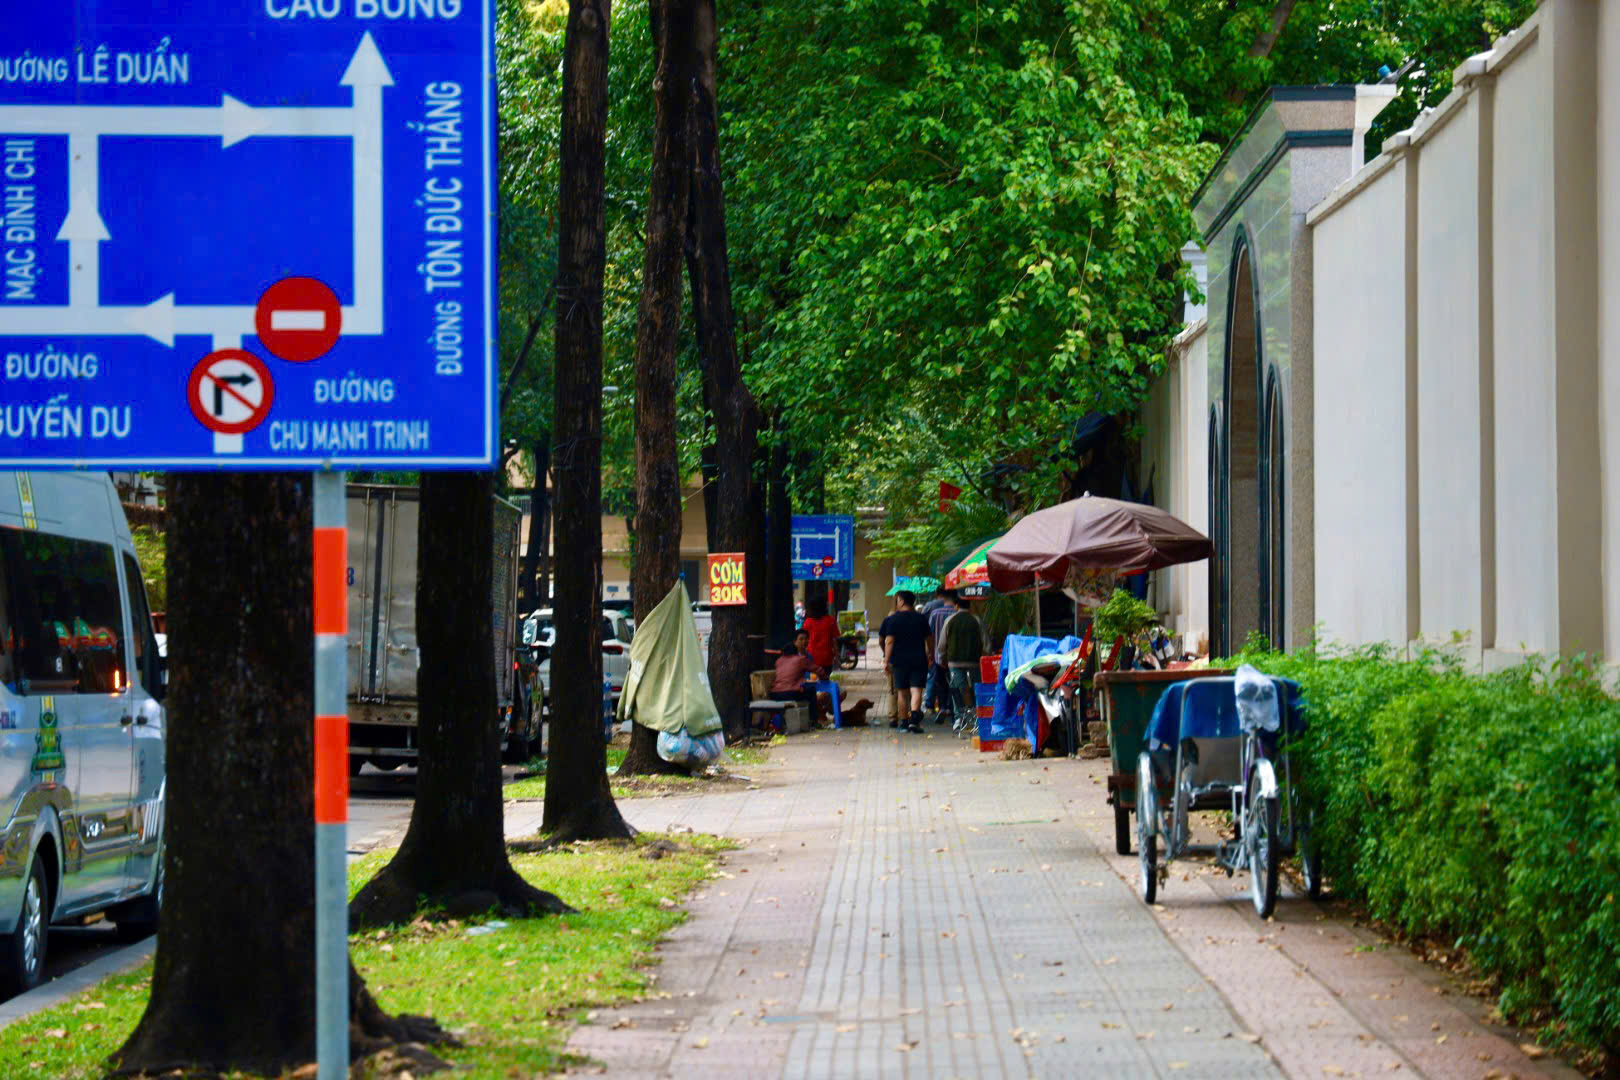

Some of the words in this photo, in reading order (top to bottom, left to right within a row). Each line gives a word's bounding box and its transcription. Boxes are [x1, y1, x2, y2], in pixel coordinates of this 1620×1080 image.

[0, 49, 68, 82] ƯỜNG
[77, 43, 109, 83] LÊ
[116, 35, 189, 84] DUẨN
[406, 81, 462, 171] THẮNG
[5, 139, 36, 180] CHI
[415, 177, 463, 233] ĐỨC
[5, 248, 43, 299] MẠC
[417, 240, 463, 294] TÔN
[426, 300, 463, 376] ĐƯỜNG
[6, 343, 99, 379] ĐƯỜNG
[313, 370, 395, 403] ĐƯỜNG
[91, 405, 131, 439] DU
[269, 420, 309, 451] CHU
[312, 420, 368, 457] MẠNH
[372, 420, 430, 451] TRINH
[711, 557, 744, 585] CƠM
[711, 585, 745, 603] 30K
